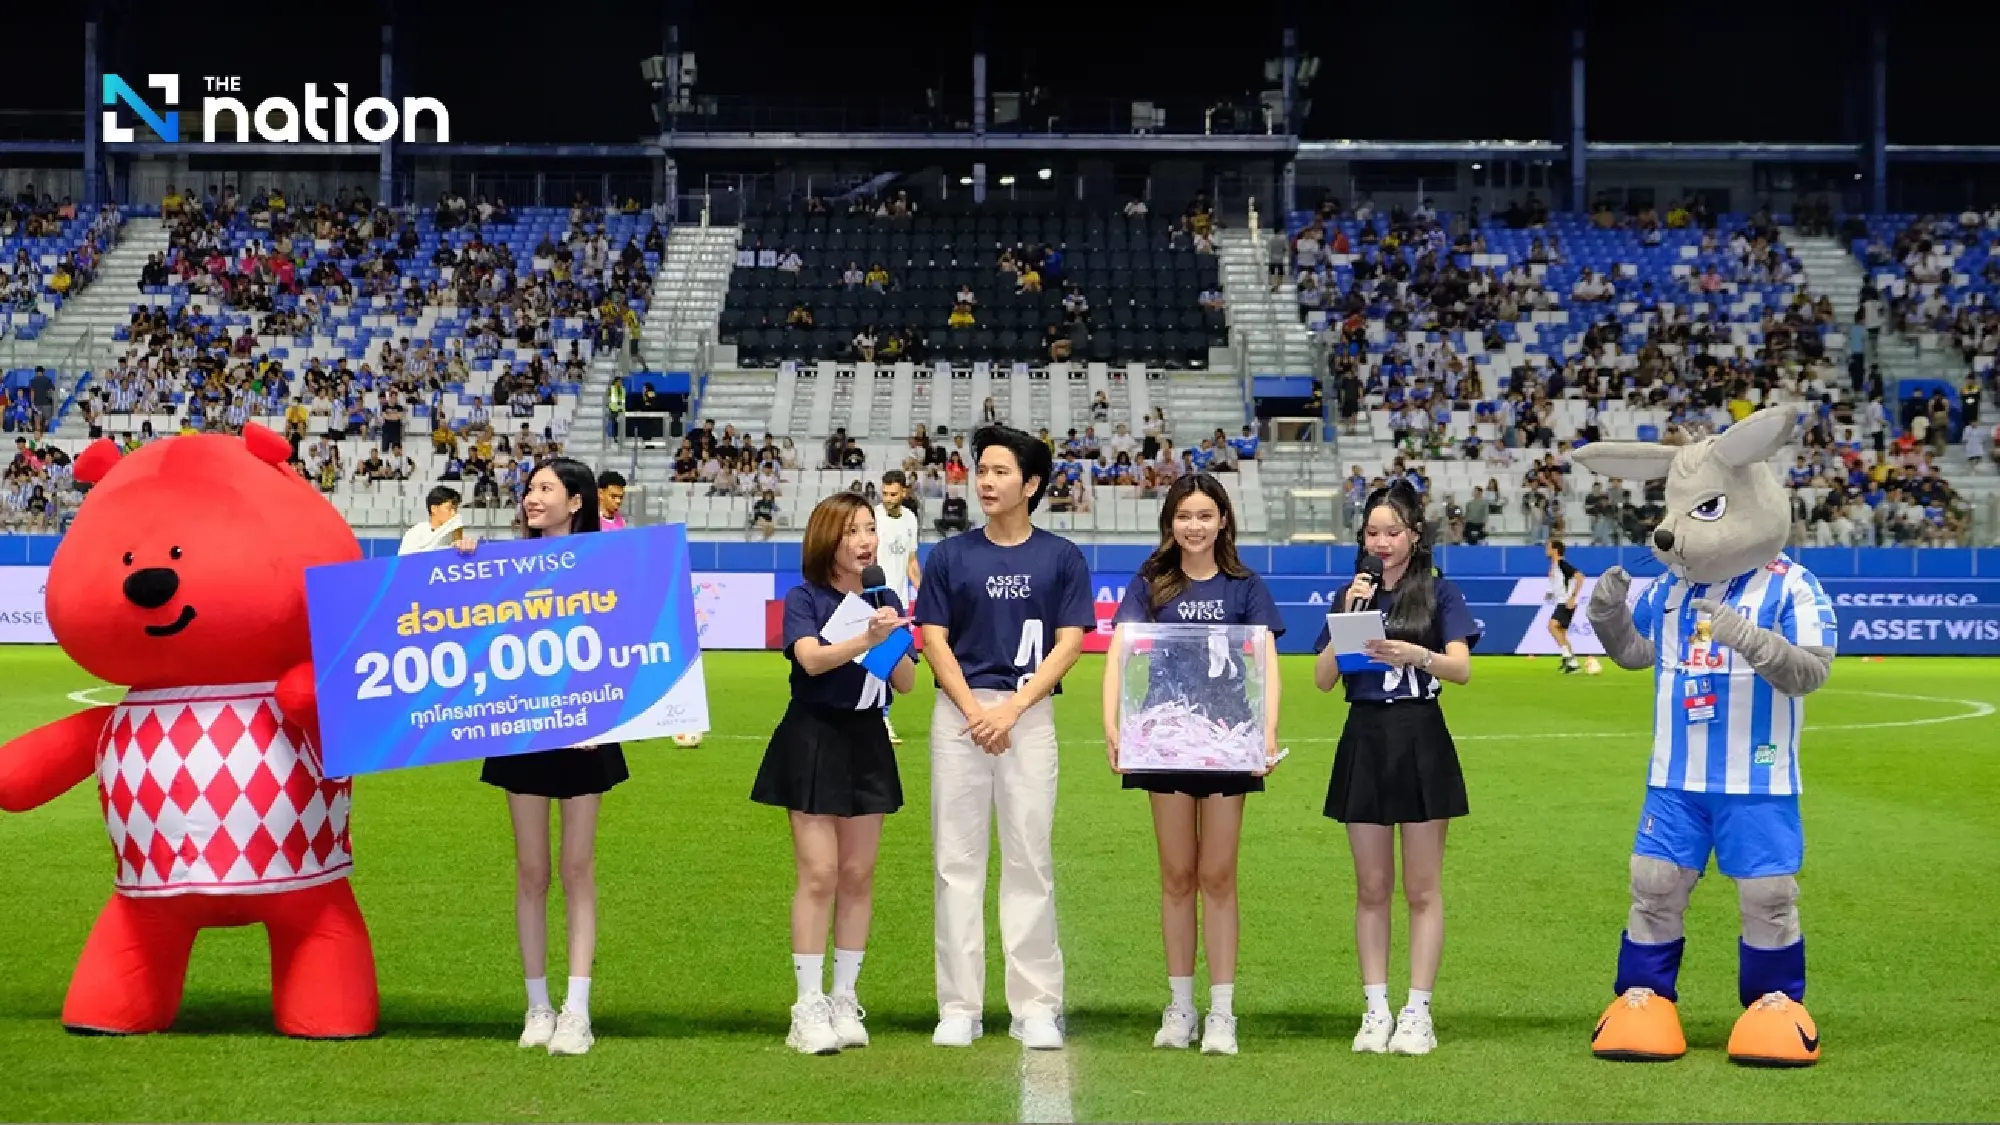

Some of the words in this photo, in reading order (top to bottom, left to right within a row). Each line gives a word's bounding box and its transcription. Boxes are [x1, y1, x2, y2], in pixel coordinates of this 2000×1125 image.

[986, 575, 1031, 586] ASSET
[0, 611, 43, 625] ASSE
[397, 589, 618, 636] ส่วนลดพิเศษ
[355, 625, 602, 700] 200,000
[608, 640, 671, 668] บาท
[410, 684, 624, 729] ทุกโครงการบ้านและคอนโด
[451, 724, 484, 741] จาก
[491, 707, 588, 736] แอสเซทไวส์
